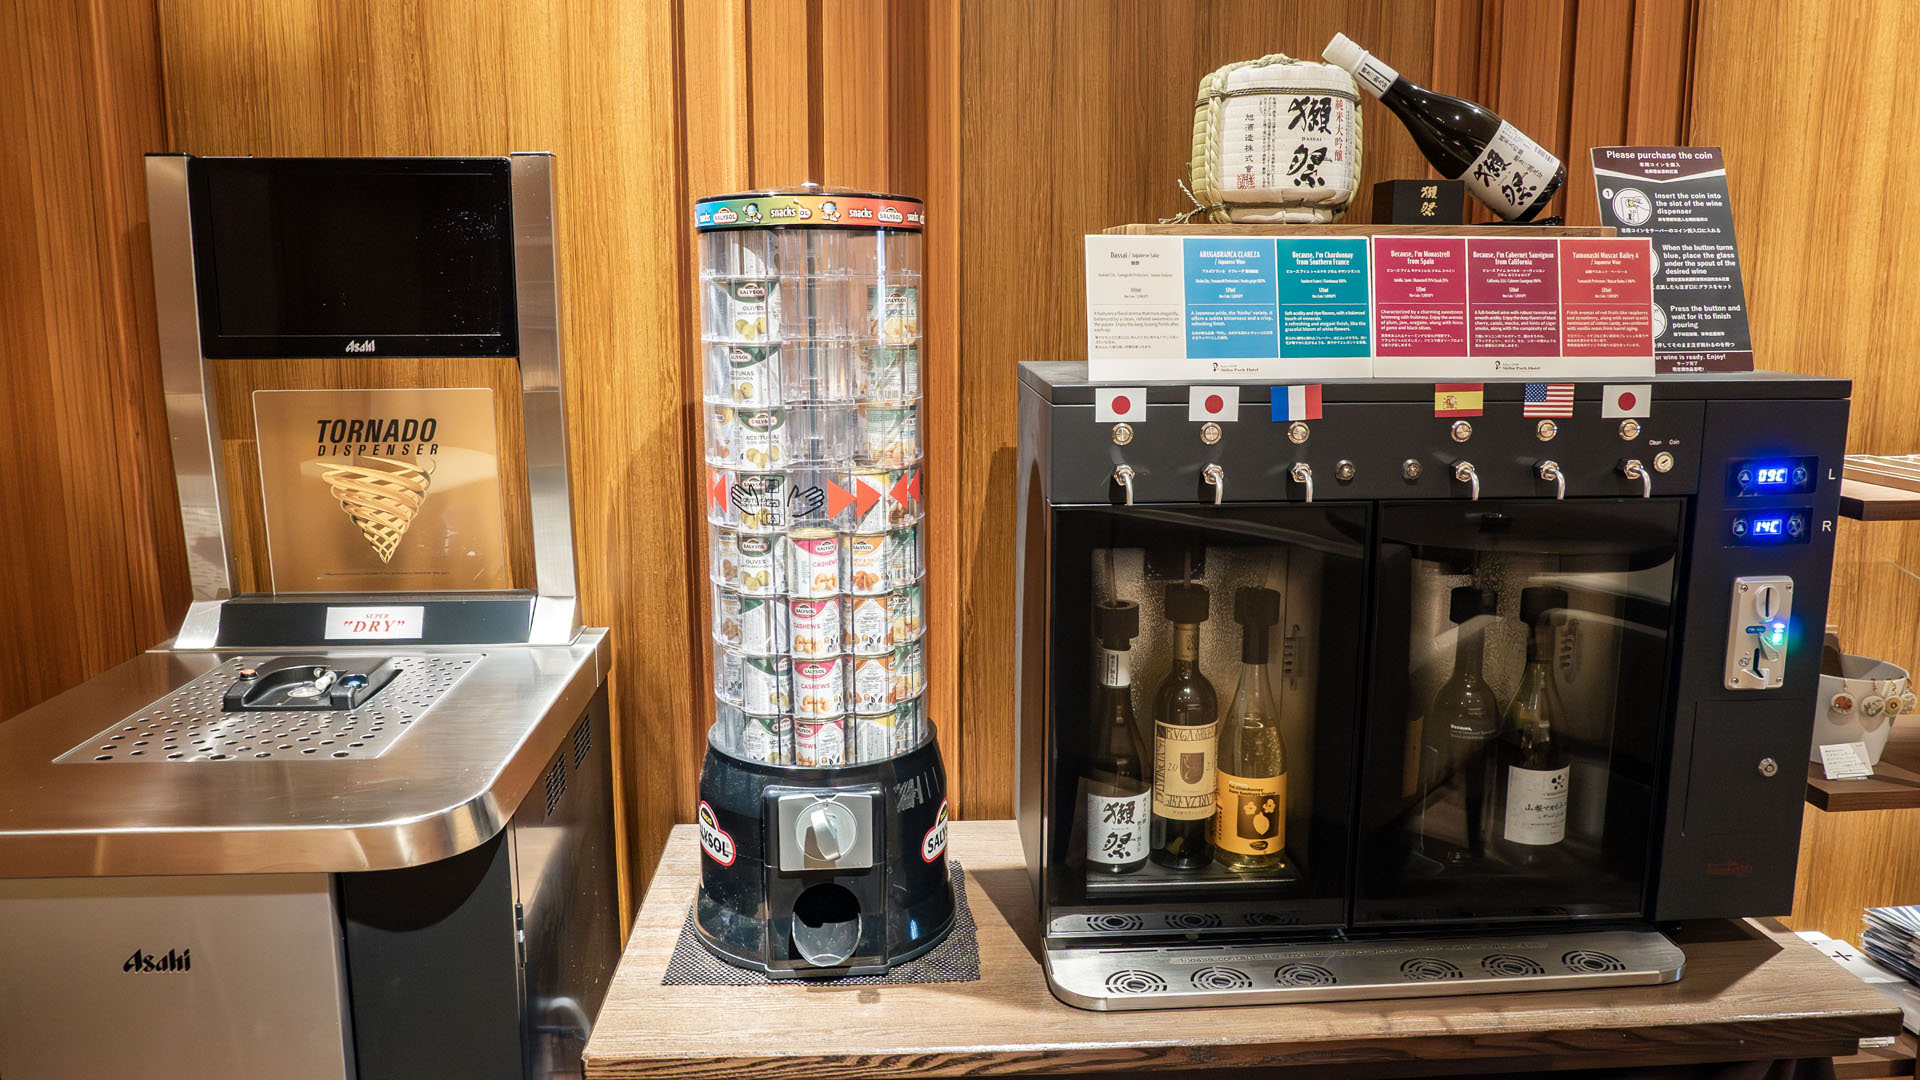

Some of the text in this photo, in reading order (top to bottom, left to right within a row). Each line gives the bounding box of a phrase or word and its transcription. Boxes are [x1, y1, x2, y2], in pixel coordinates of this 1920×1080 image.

[1334, 98, 1344, 162] 純米大吟醸
[1606, 151, 1635, 159] Please
[1637, 152, 1676, 160] purchase
[1678, 151, 1692, 159] the
[1420, 186, 1438, 216] 獺祭
[770, 206, 796, 217] snacks
[849, 208, 873, 218] snacks
[1391, 250, 1413, 258] Because,
[1619, 252, 1634, 260] Bailey
[346, 339, 375, 353] Asahi
[317, 418, 437, 444] TORNADO
[318, 444, 439, 457] DISPENSER
[1828, 469, 1836, 480] L
[1822, 521, 1831, 532] R
[122, 948, 192, 974] Asahi
